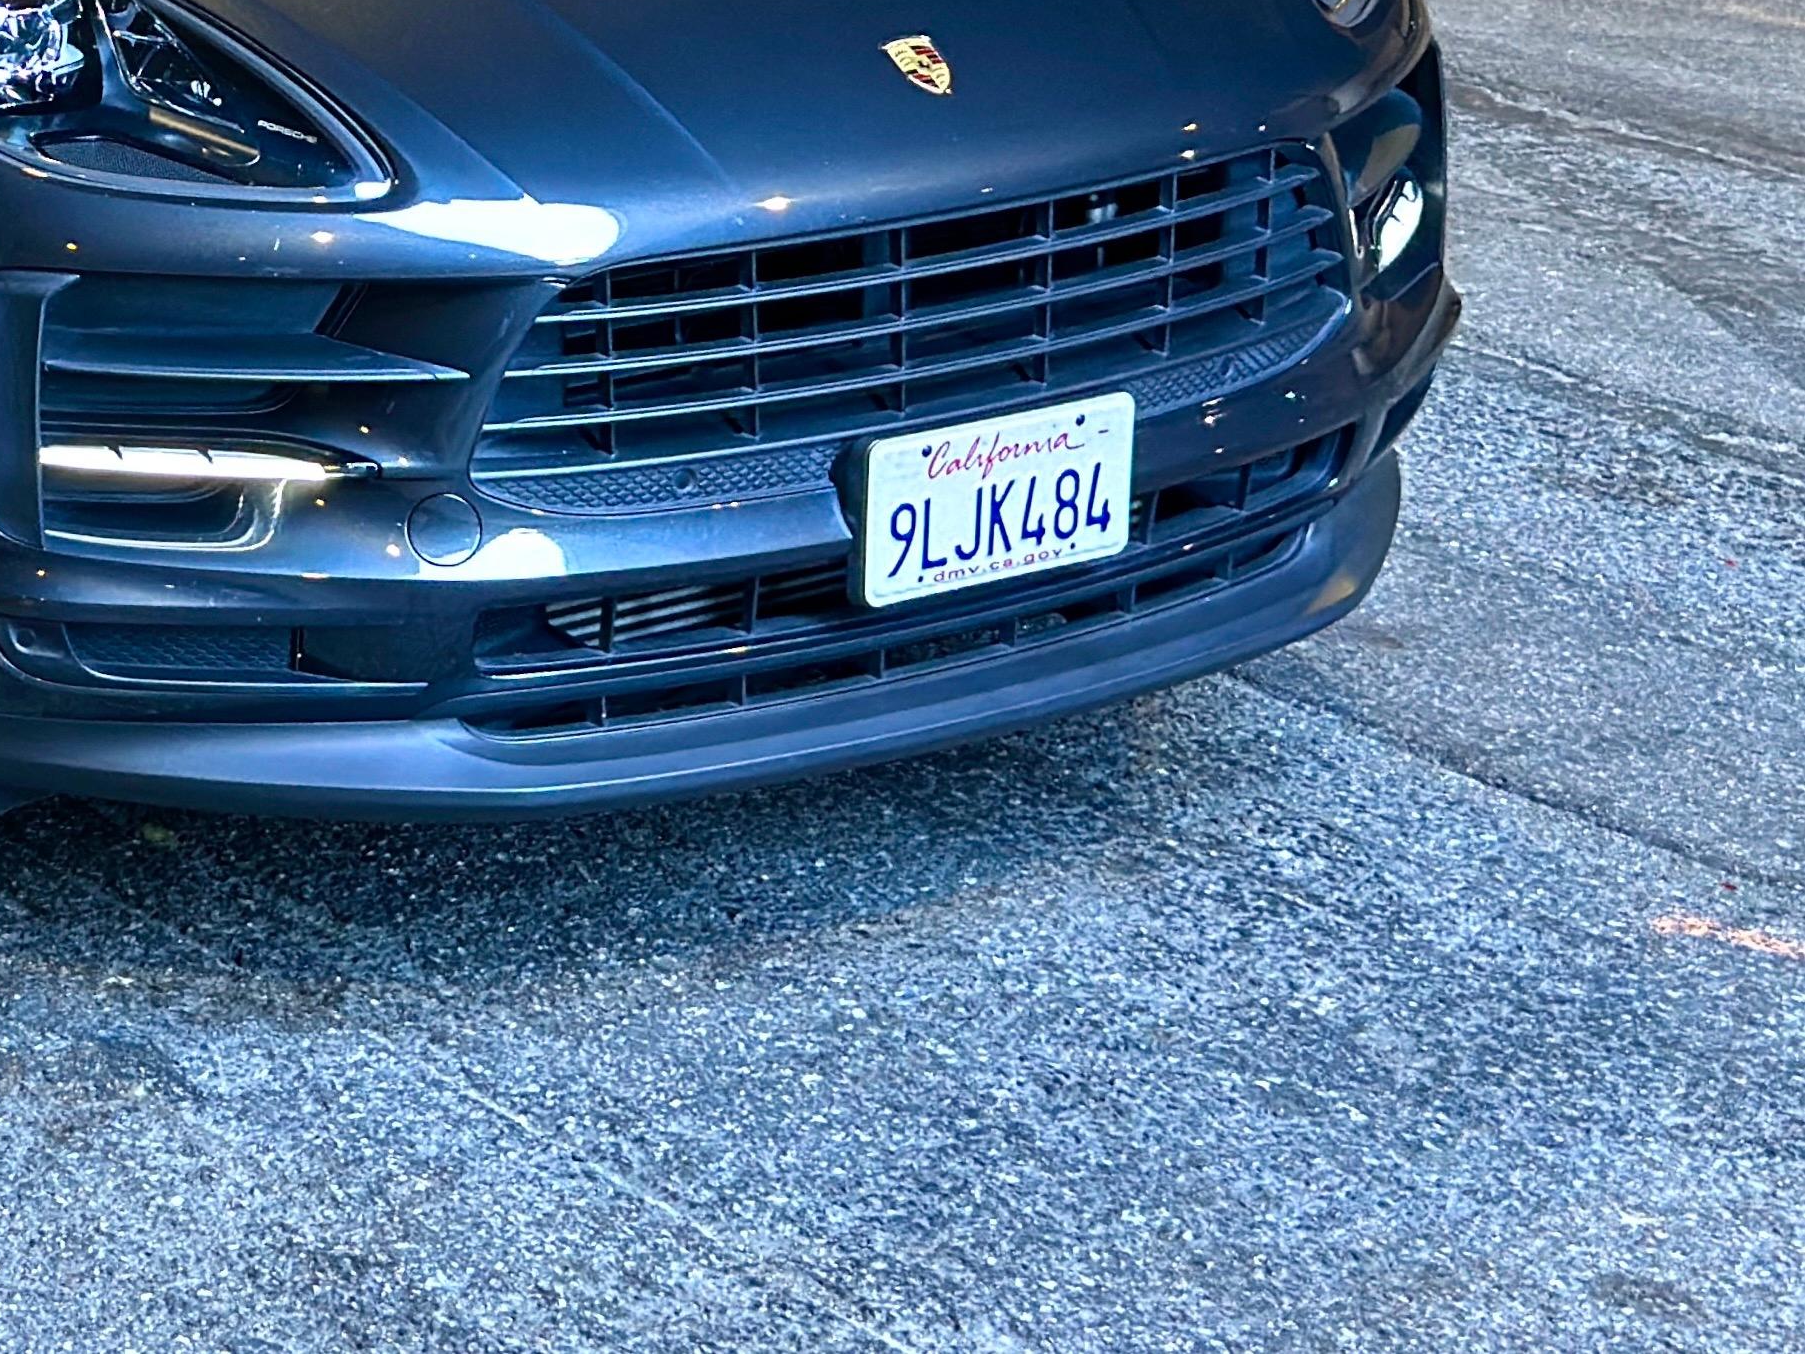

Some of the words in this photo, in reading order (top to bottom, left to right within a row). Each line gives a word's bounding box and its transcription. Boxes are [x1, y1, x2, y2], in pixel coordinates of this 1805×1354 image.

[927, 431, 1085, 480] California
[887, 461, 1111, 578] 9LJK484
[933, 548, 1063, 583] dmv.ca.gov
